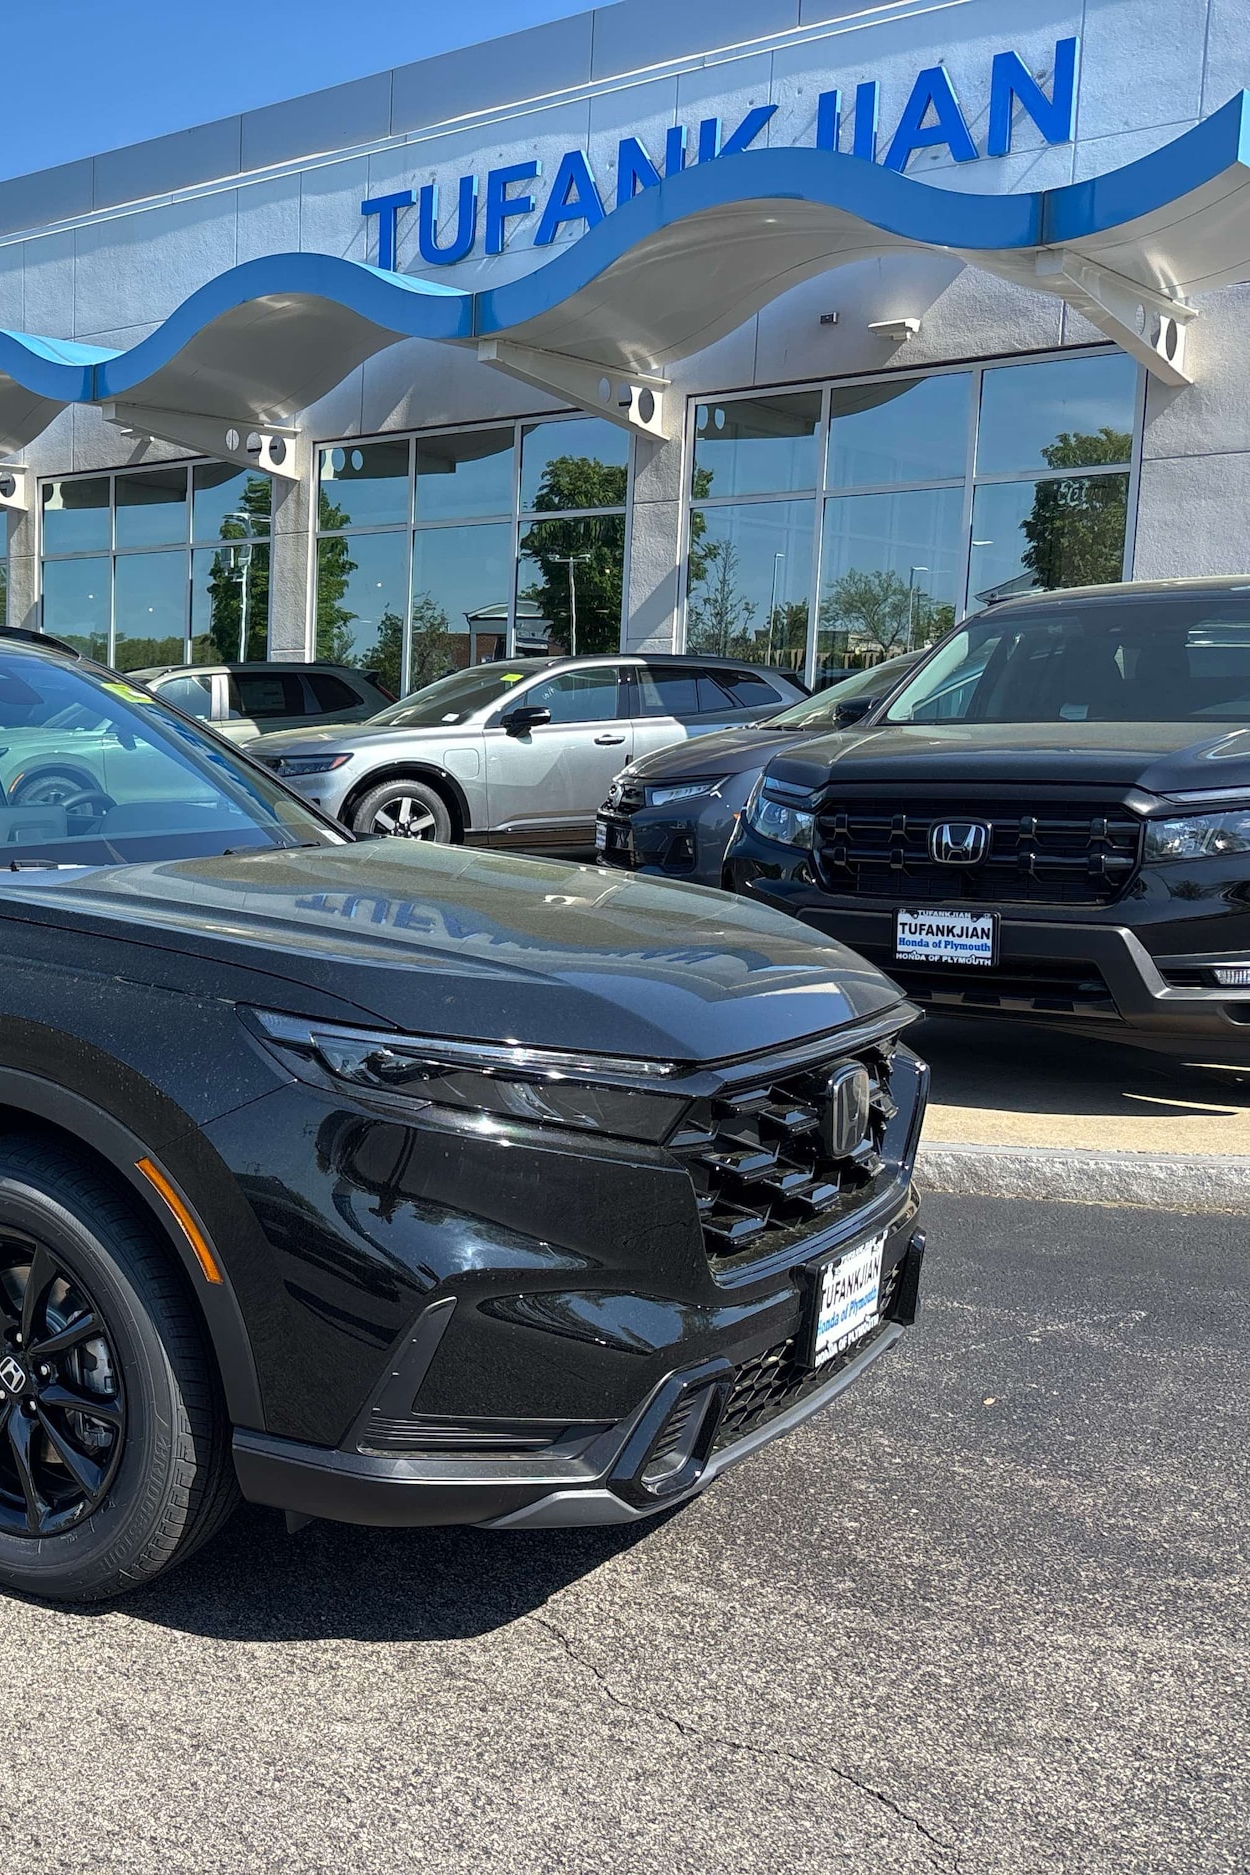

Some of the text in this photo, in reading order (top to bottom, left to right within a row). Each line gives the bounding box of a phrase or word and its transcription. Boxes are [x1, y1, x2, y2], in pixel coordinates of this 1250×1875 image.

[917, 910, 971, 919] TUFANKJIAN
[899, 922, 991, 940] TUFANKJIAN
[898, 937, 991, 952] Honda of Plymouth
[896, 953, 926, 961] HONDA
[942, 956, 991, 966] PLYMOUTH
[840, 1303, 849, 1320] of
[849, 1285, 877, 1317] Plymouth
